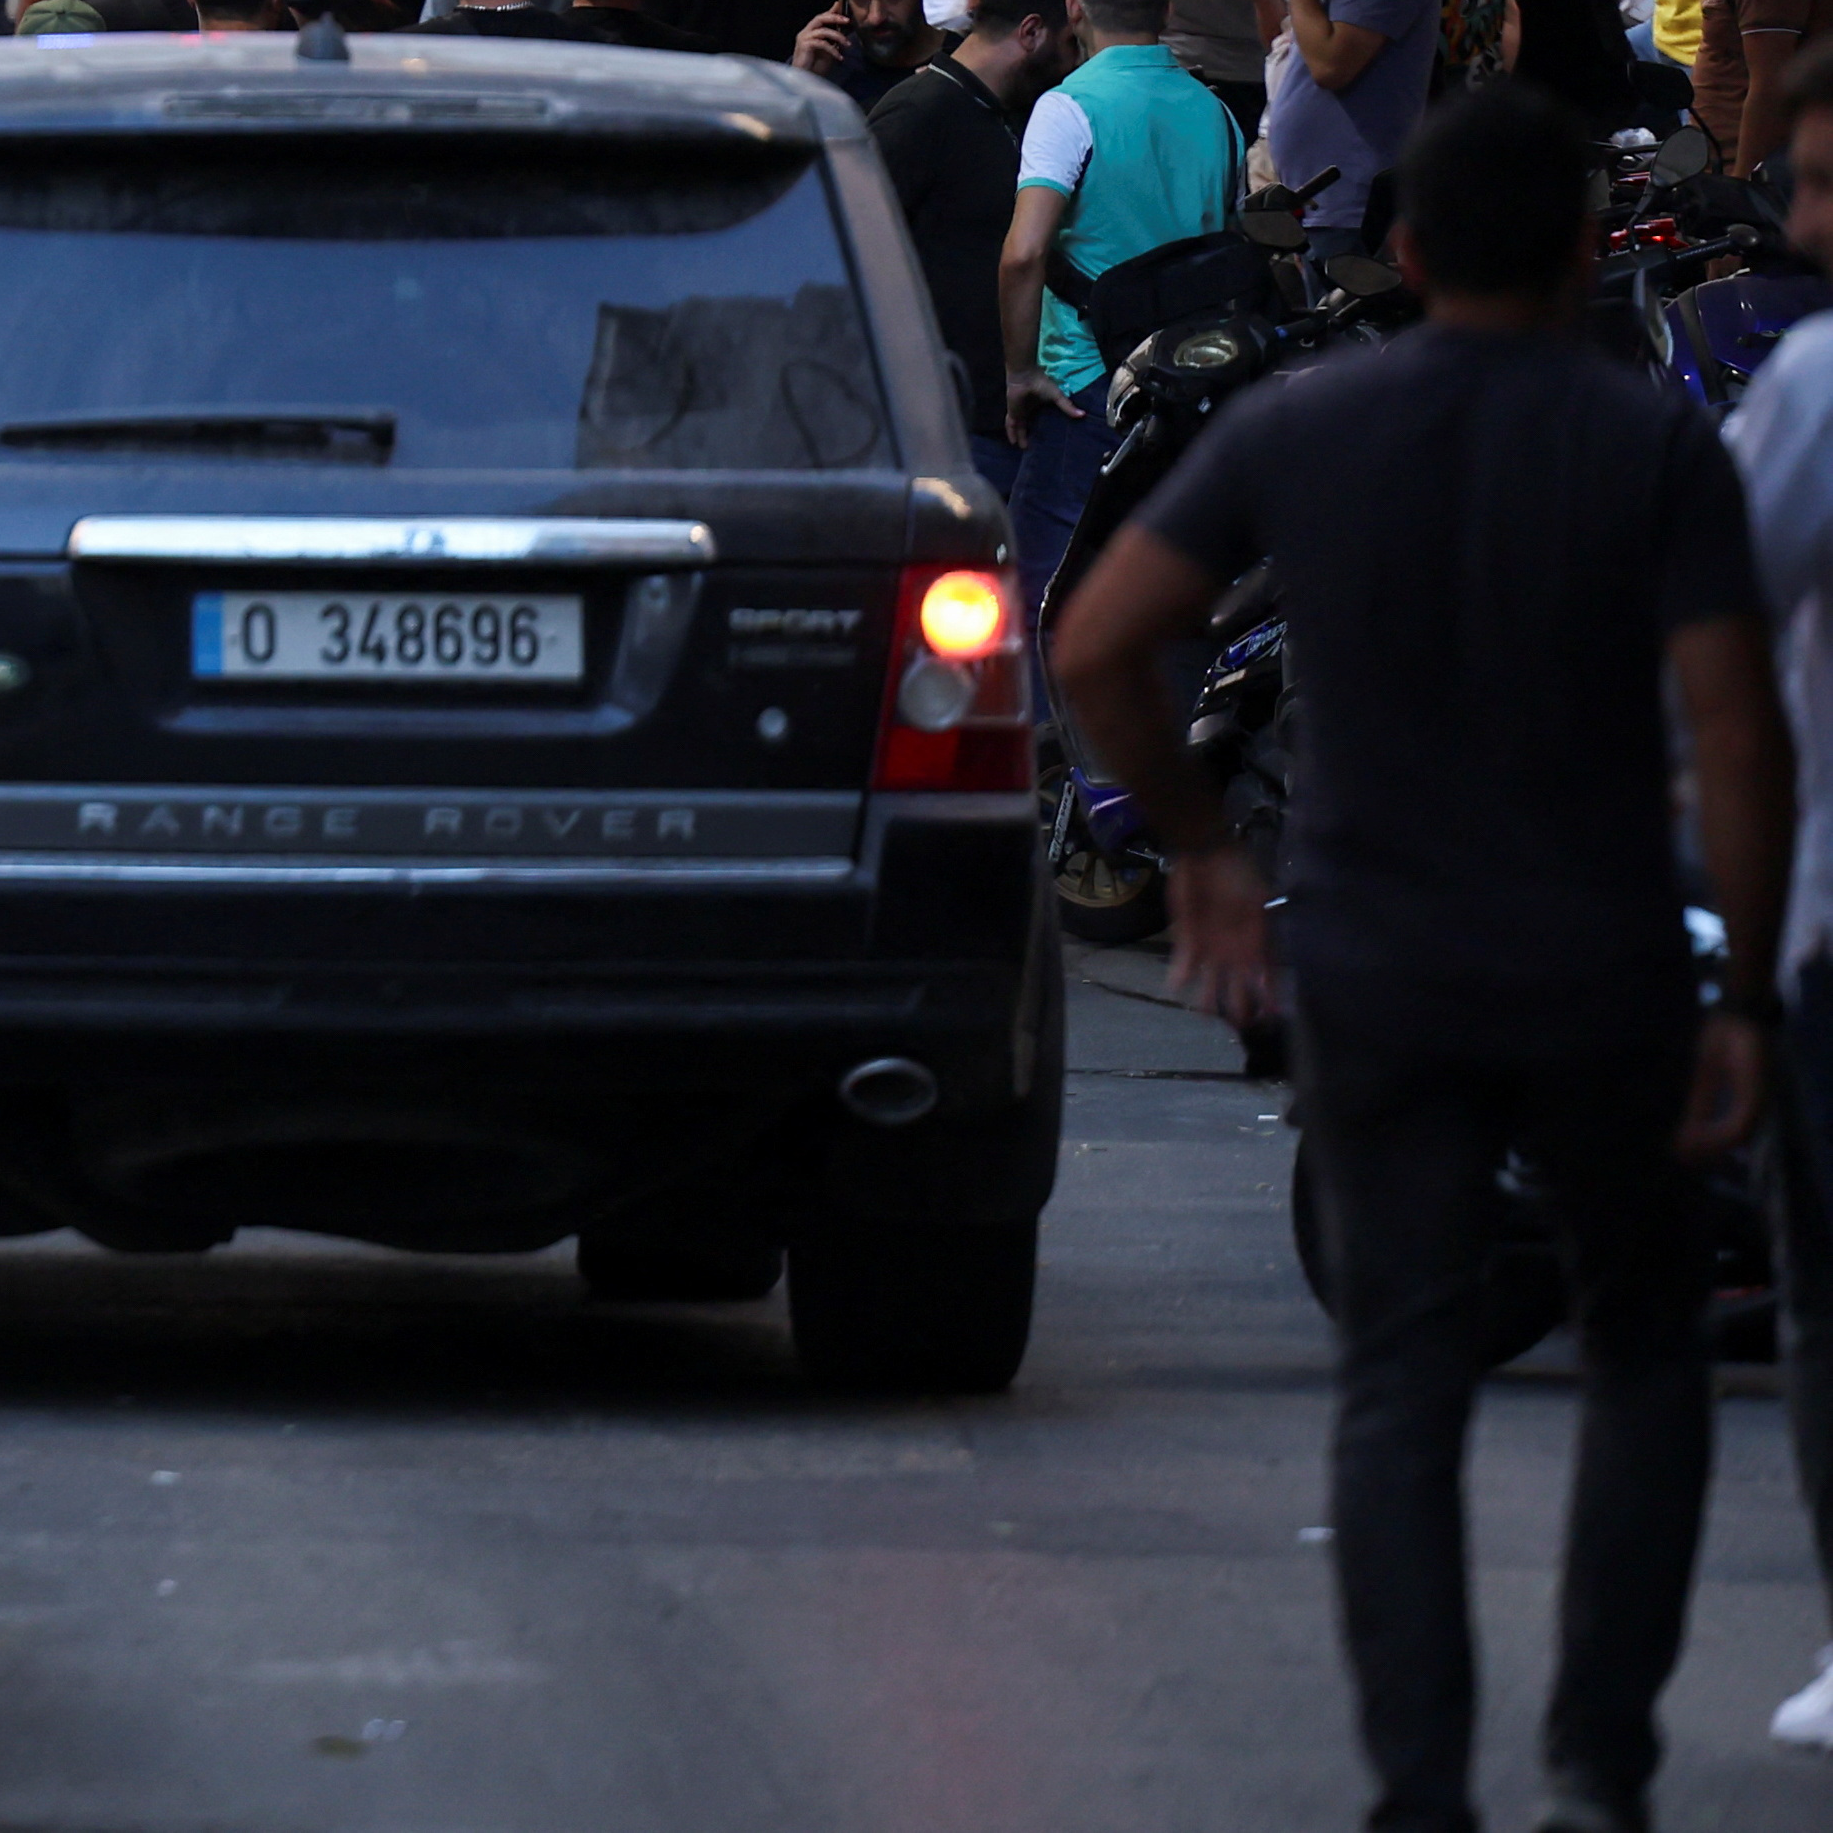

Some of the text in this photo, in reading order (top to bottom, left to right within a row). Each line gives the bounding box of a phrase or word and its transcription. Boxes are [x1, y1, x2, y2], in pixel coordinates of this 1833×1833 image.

[317, 600, 540, 666] 348696
[78, 802, 696, 841] RANGE ROVER
